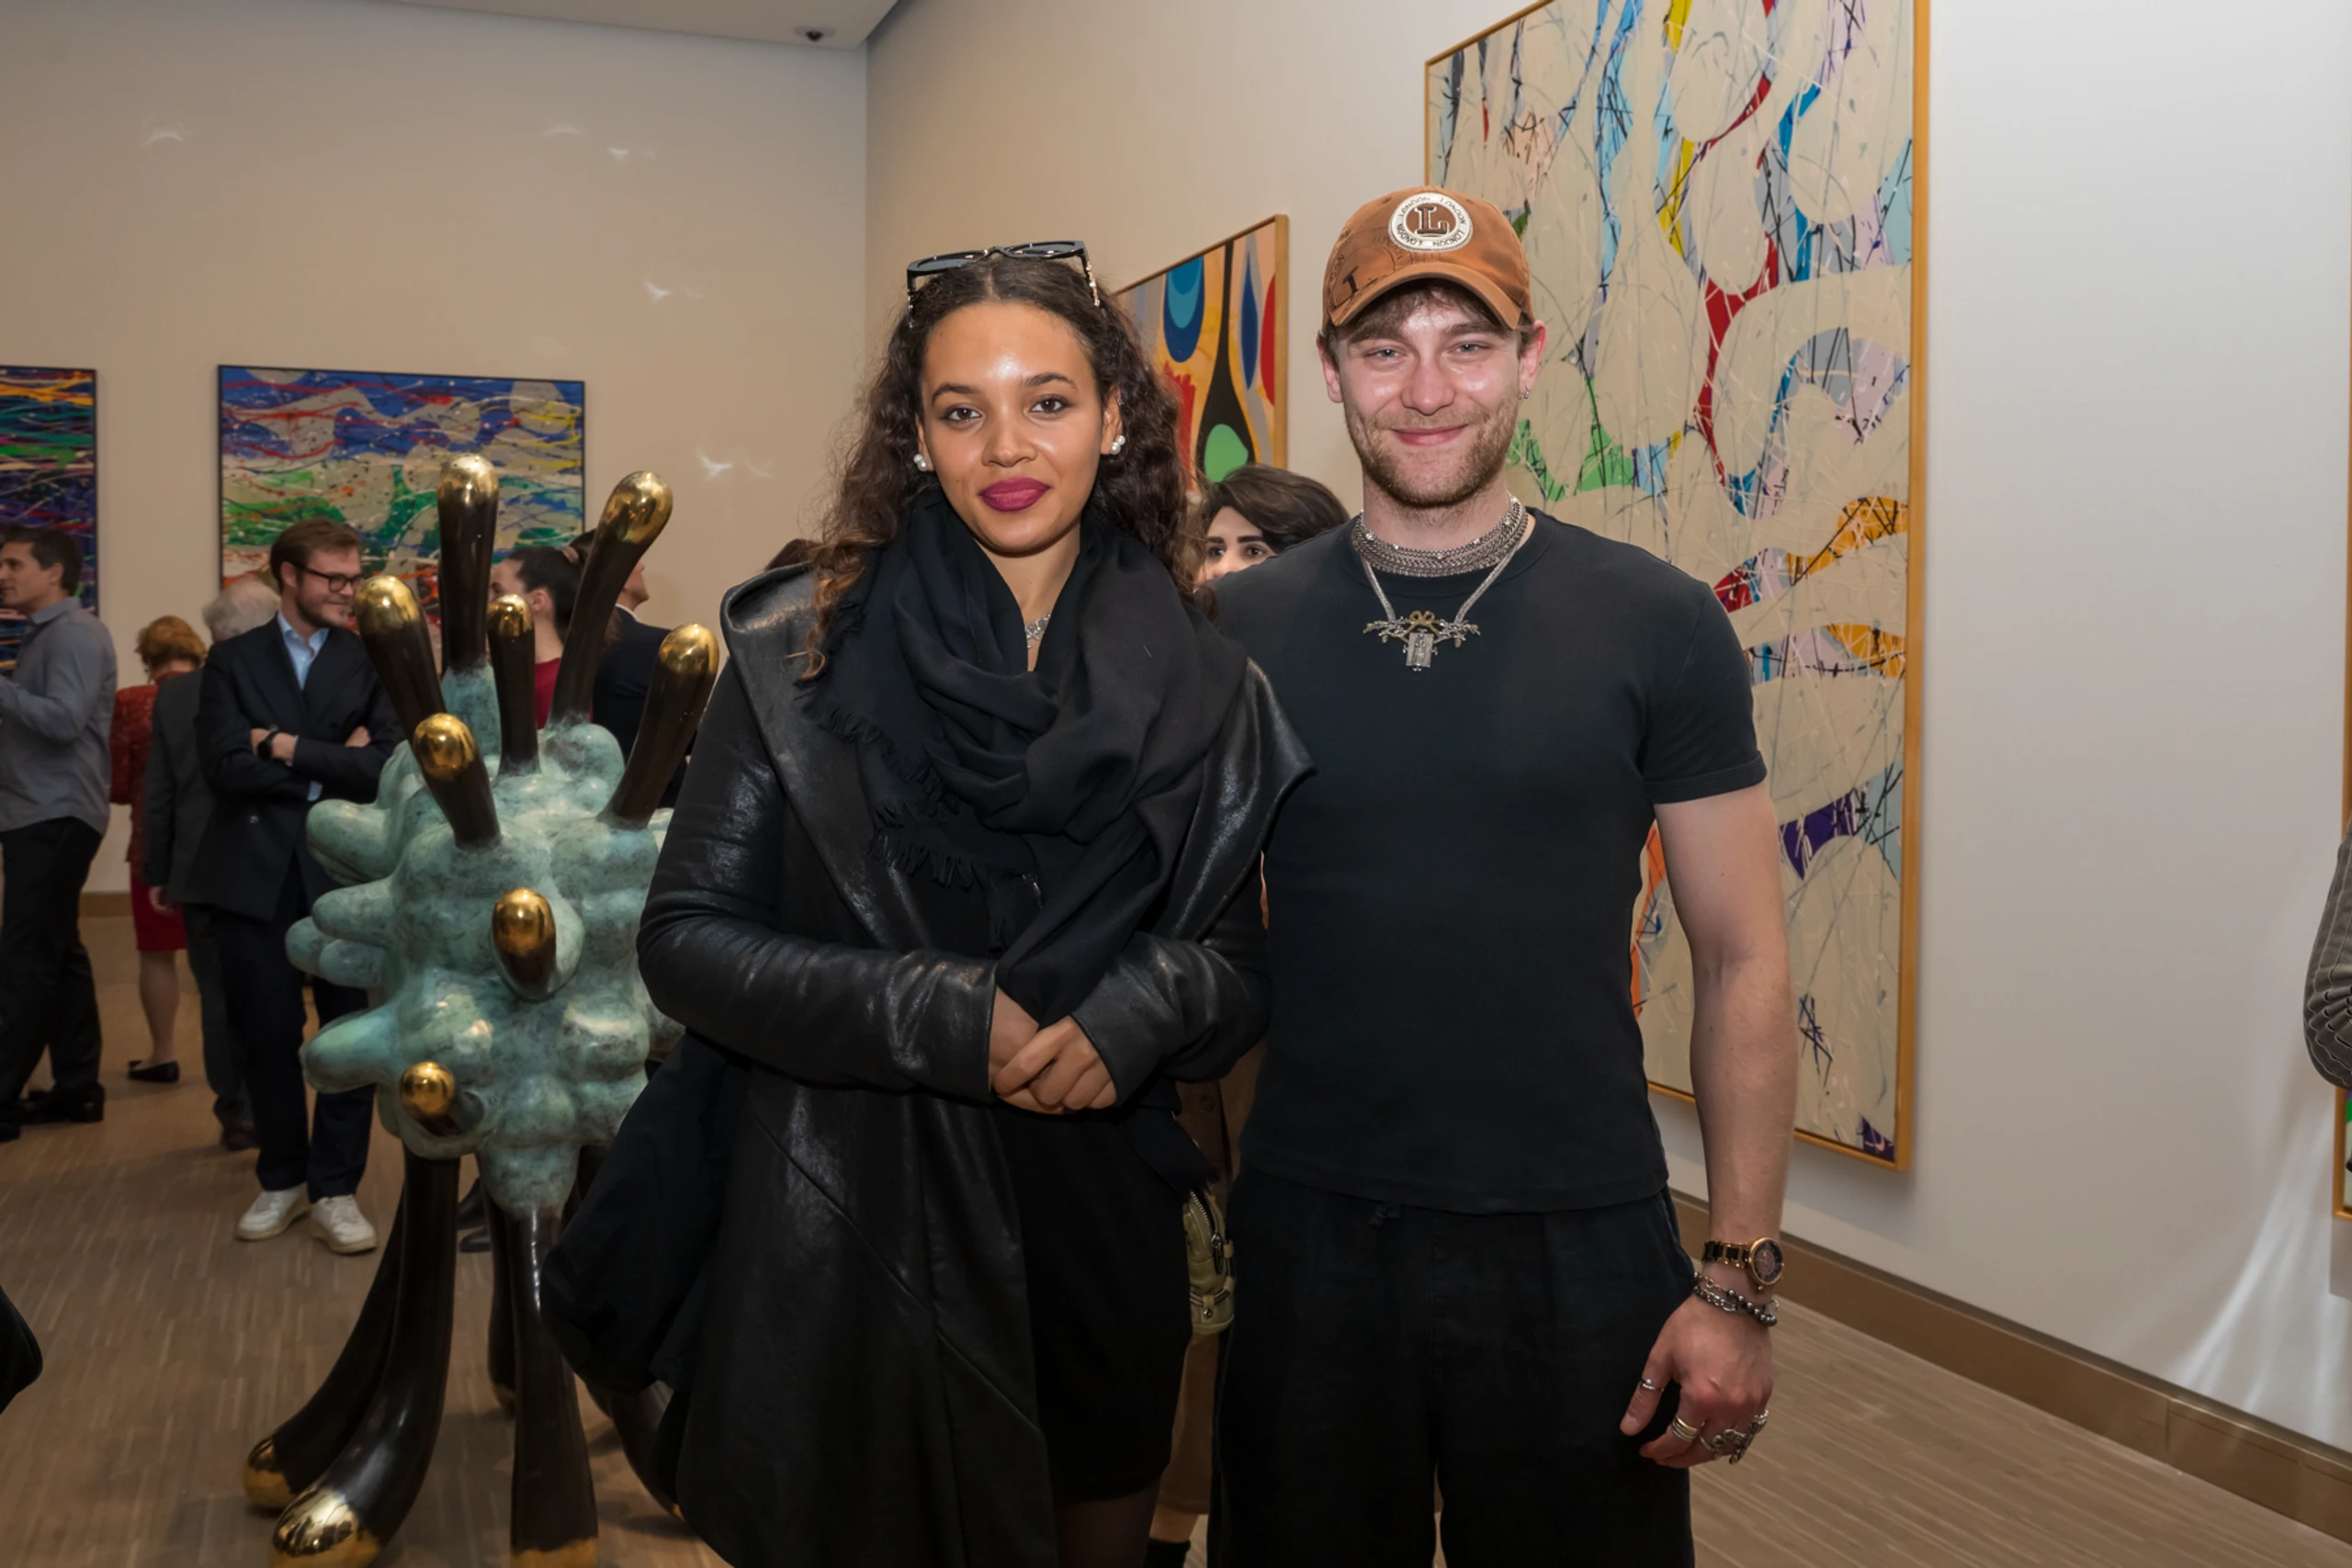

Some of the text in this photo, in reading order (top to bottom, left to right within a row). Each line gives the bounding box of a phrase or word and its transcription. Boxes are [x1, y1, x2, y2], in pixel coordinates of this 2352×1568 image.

[1415, 205, 1449, 235] L
[1440, 197, 1466, 224] LONDON
[1396, 223, 1423, 246] LONDON
[1433, 230, 1465, 246] LONDON
